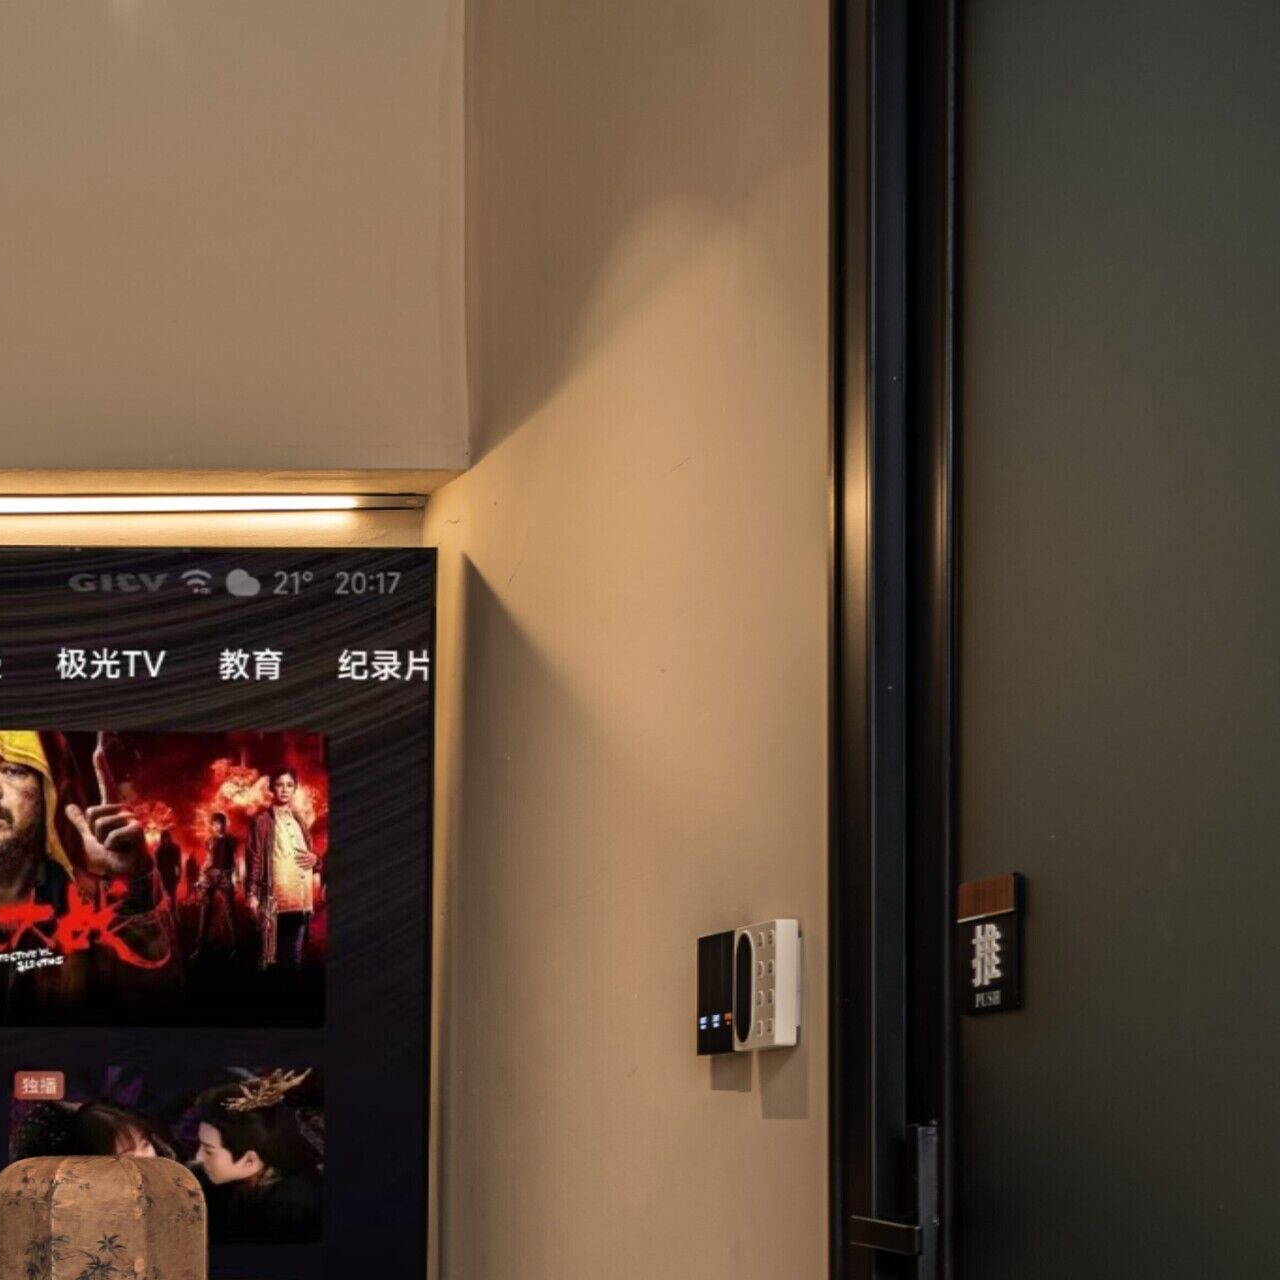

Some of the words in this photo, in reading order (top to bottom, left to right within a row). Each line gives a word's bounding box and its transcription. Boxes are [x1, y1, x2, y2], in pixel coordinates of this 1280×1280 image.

[335, 571, 402, 595] 20:17
[57, 648, 166, 680] 极光TV
[219, 649, 283, 681] 教育
[338, 649, 429, 681] 纪录片
[971, 923, 1001, 988] 推
[975, 990, 1001, 1008] PUSH
[22, 1076, 57, 1097] 独播
